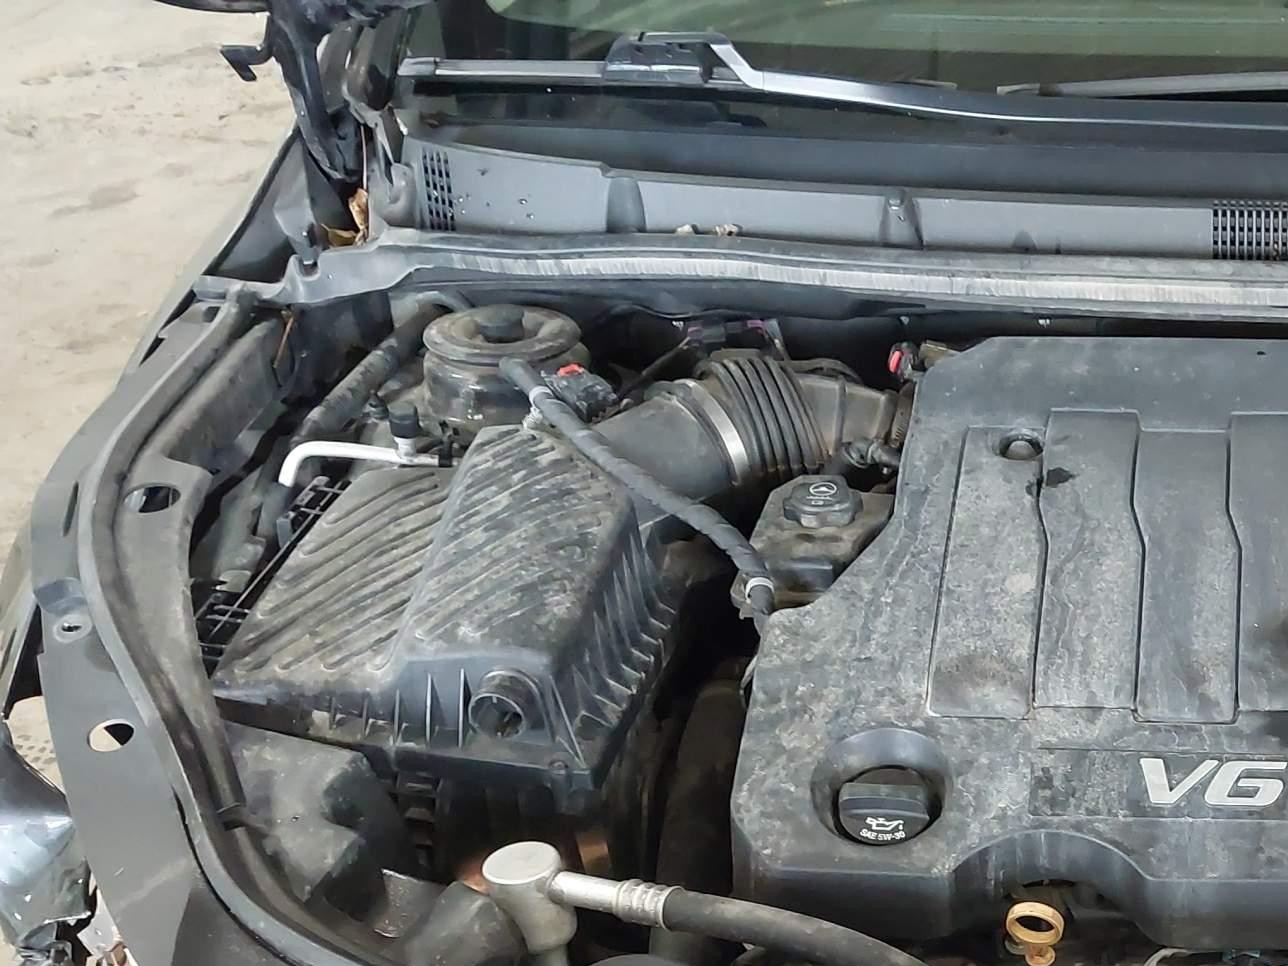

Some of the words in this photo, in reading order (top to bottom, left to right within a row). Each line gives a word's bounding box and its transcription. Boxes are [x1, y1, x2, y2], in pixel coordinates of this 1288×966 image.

[1139, 757, 1288, 807] V6
[860, 828, 878, 840] SAE
[877, 830, 906, 841] 5W-30
